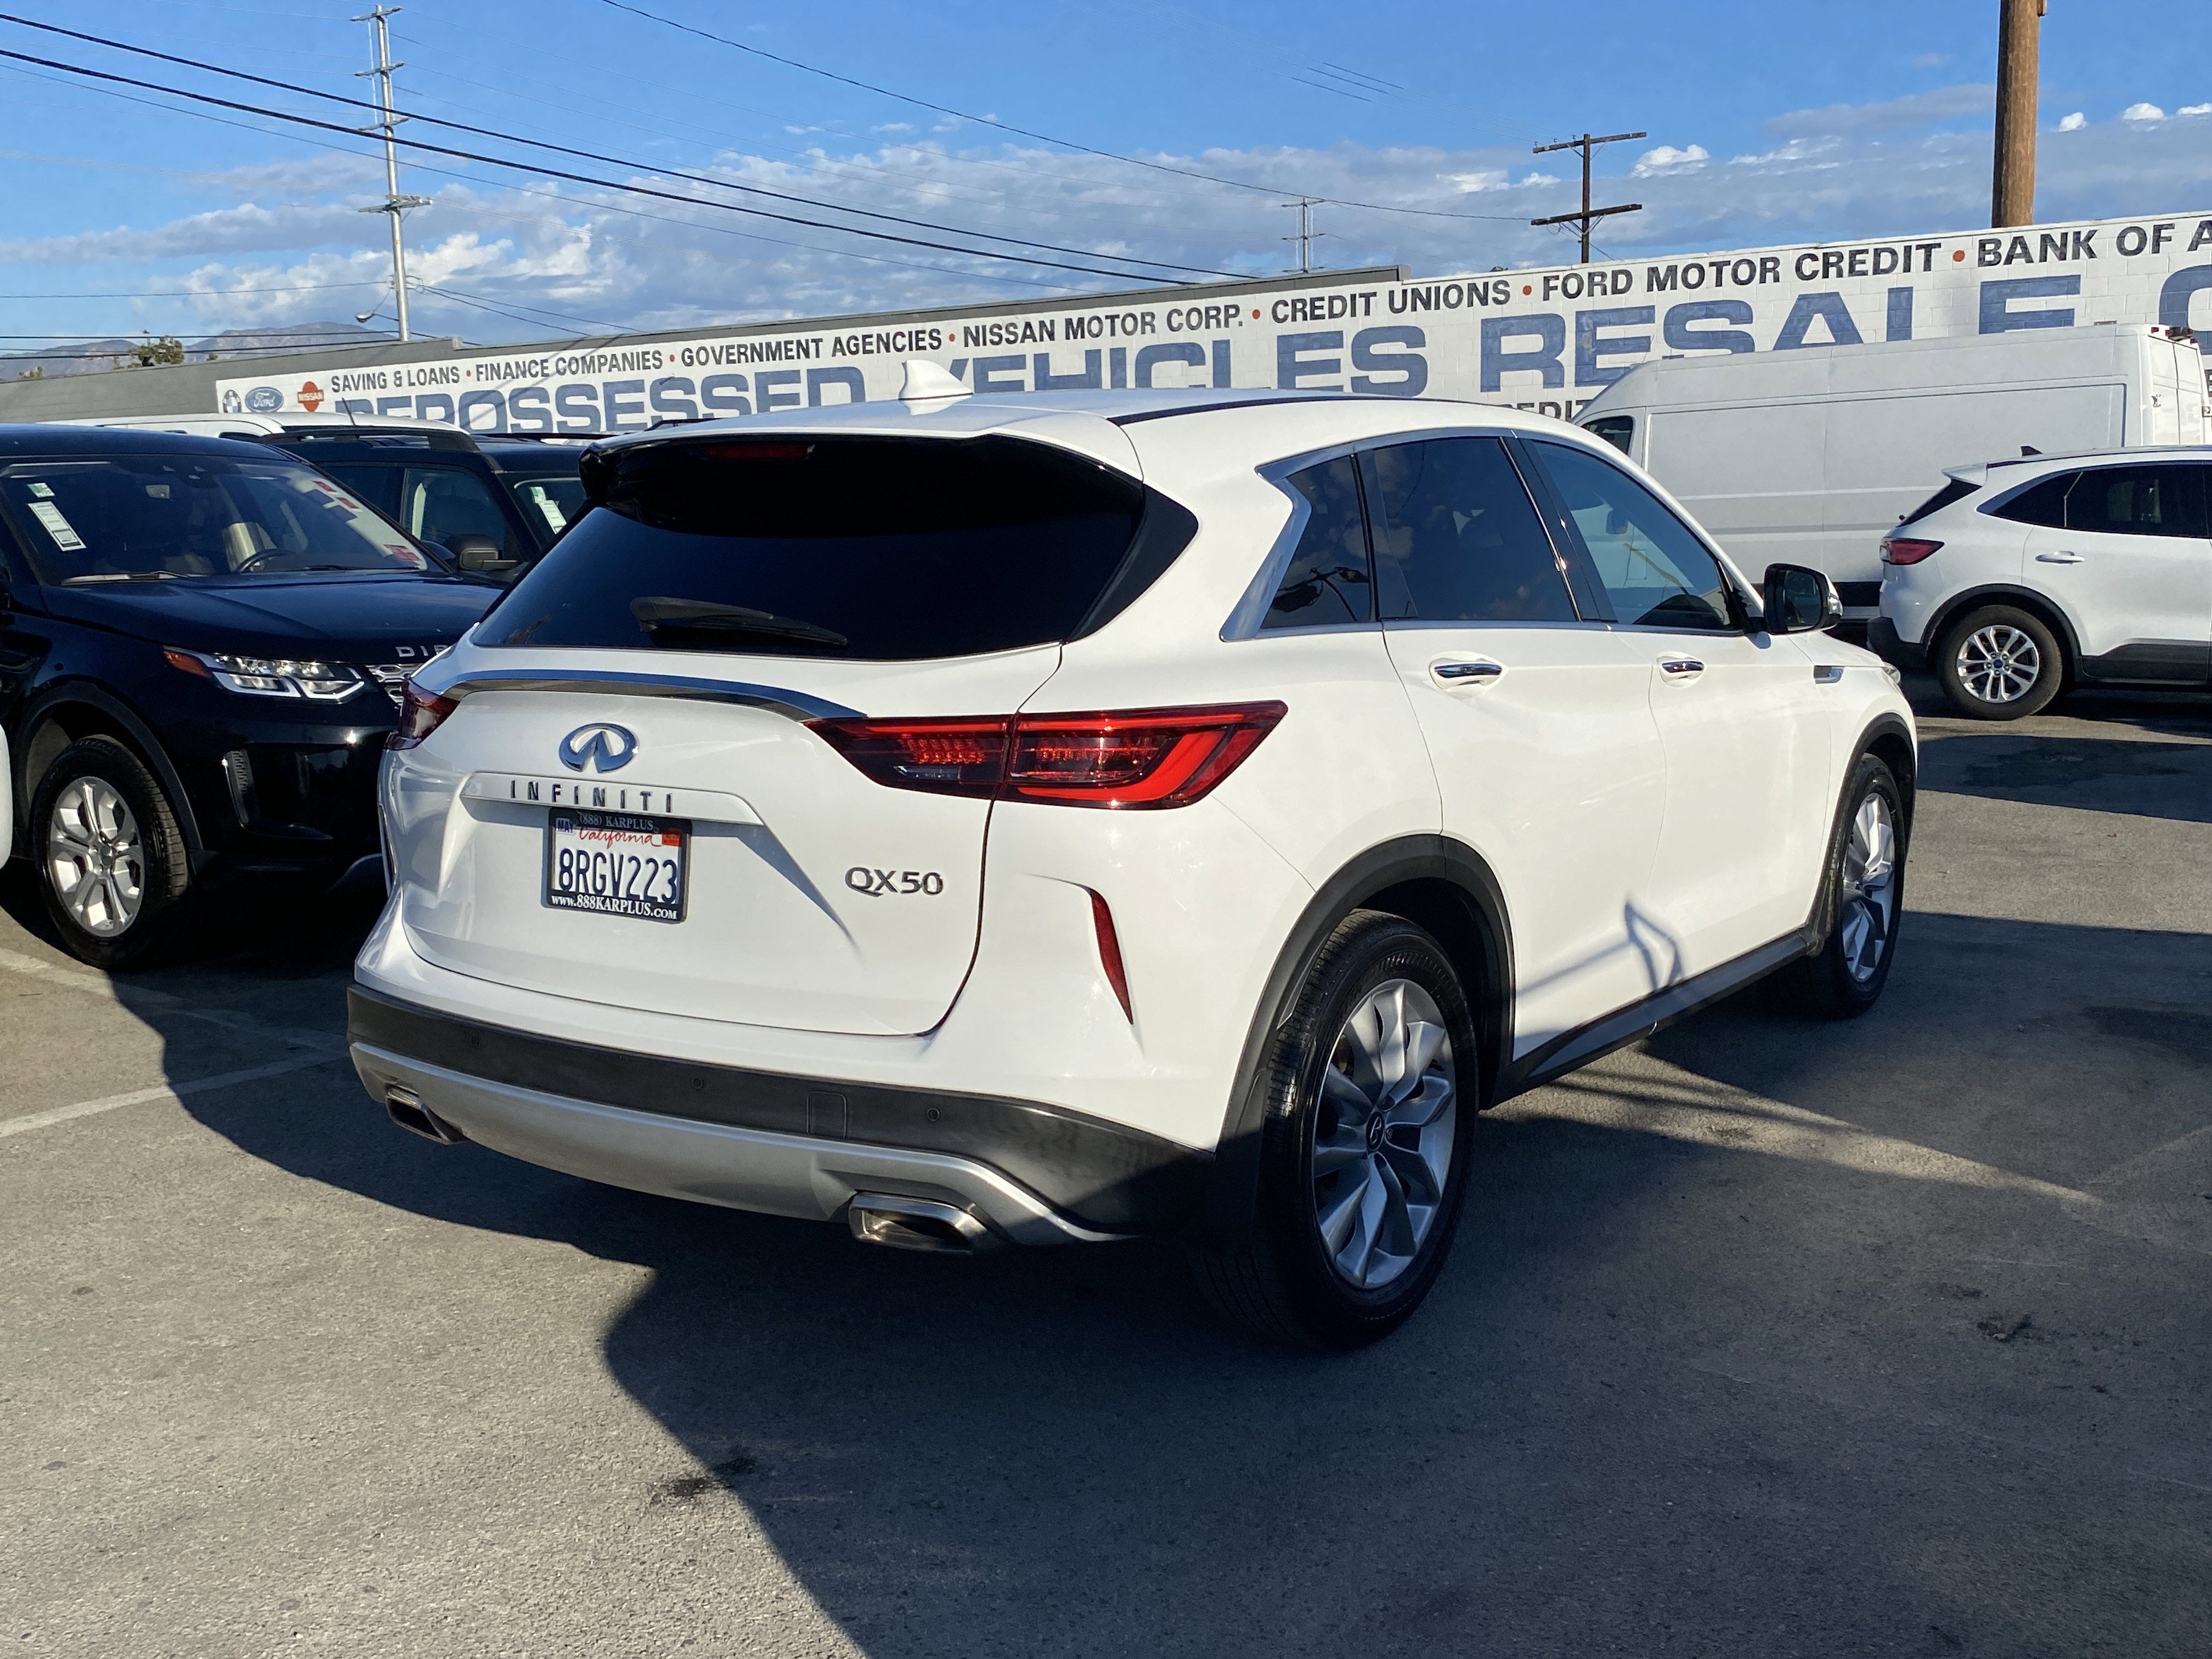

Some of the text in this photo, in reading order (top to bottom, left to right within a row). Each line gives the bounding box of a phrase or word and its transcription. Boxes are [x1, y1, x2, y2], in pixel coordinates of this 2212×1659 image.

[331, 372, 387, 393] SAVING
[393, 376, 403, 387] &
[408, 366, 460, 387] LOANS
[476, 358, 549, 382] FINANCE
[555, 350, 663, 376] COMPANIES
[681, 338, 823, 367] GOVERNMENT
[831, 328, 942, 357] AGENCIES
[963, 319, 1055, 348] NISSAN
[1064, 311, 1156, 341] MOTOR
[1166, 304, 1243, 332] CORP.
[1271, 291, 1377, 324] CREDIT
[1388, 280, 1511, 314] UNIONS
[1542, 269, 1633, 302] FORD
[1646, 256, 1780, 292] MOTOR
[1795, 242, 1942, 281] CREDIT
[1977, 229, 2098, 268] BANK
[2116, 223, 2176, 257] OF
[253, 392, 275, 408] Ford
[510, 780, 674, 813] INFINITI
[579, 826, 663, 850] California
[605, 815, 654, 831] KARPLUS
[558, 848, 678, 904] 8RGV223
[844, 866, 944, 898] QX50
